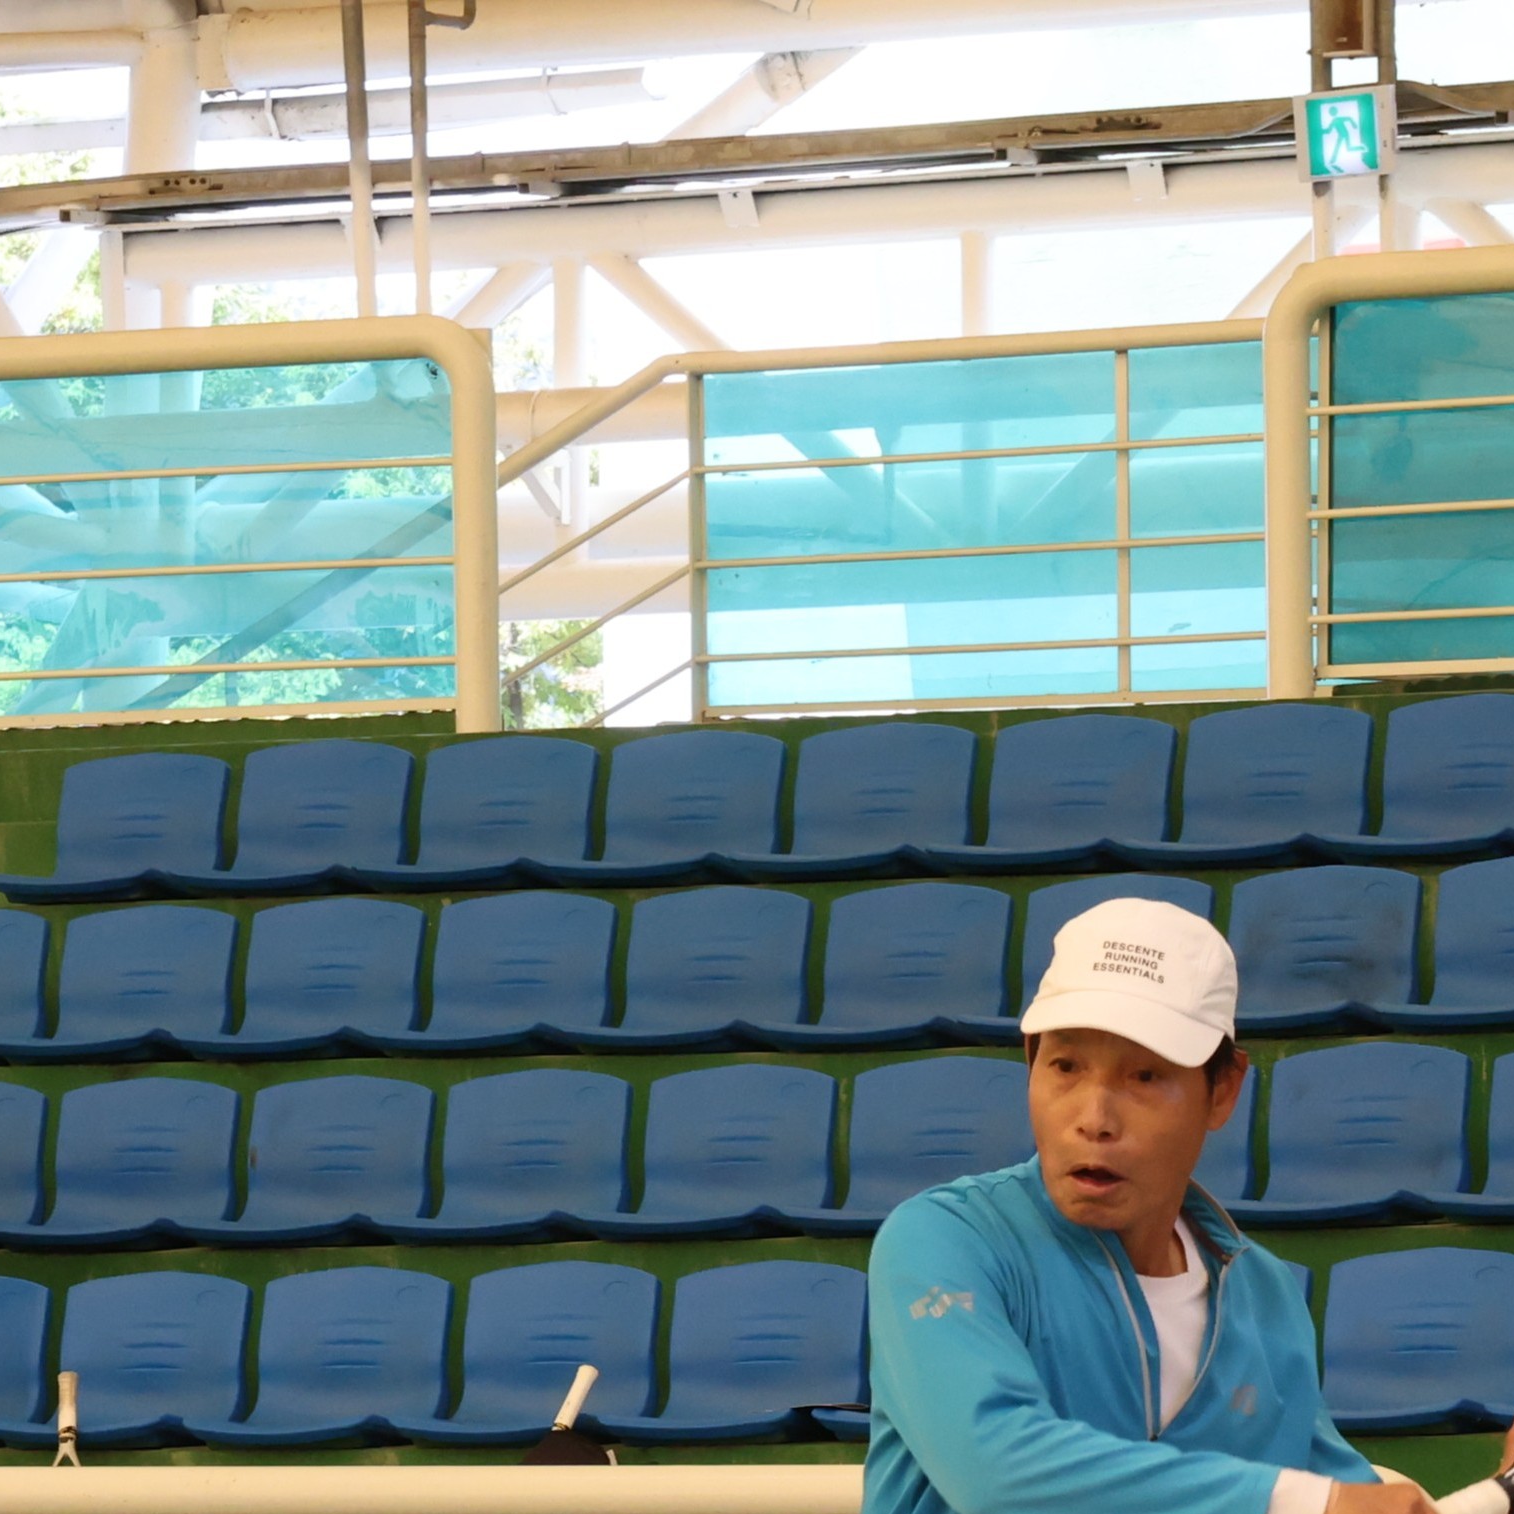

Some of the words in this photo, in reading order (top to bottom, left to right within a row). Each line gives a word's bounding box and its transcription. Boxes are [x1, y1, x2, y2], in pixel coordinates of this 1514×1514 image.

[1102, 940, 1166, 961] DESCENTE
[1104, 952, 1159, 971] RUNNING
[1092, 962, 1165, 984] ESSENTIALS
